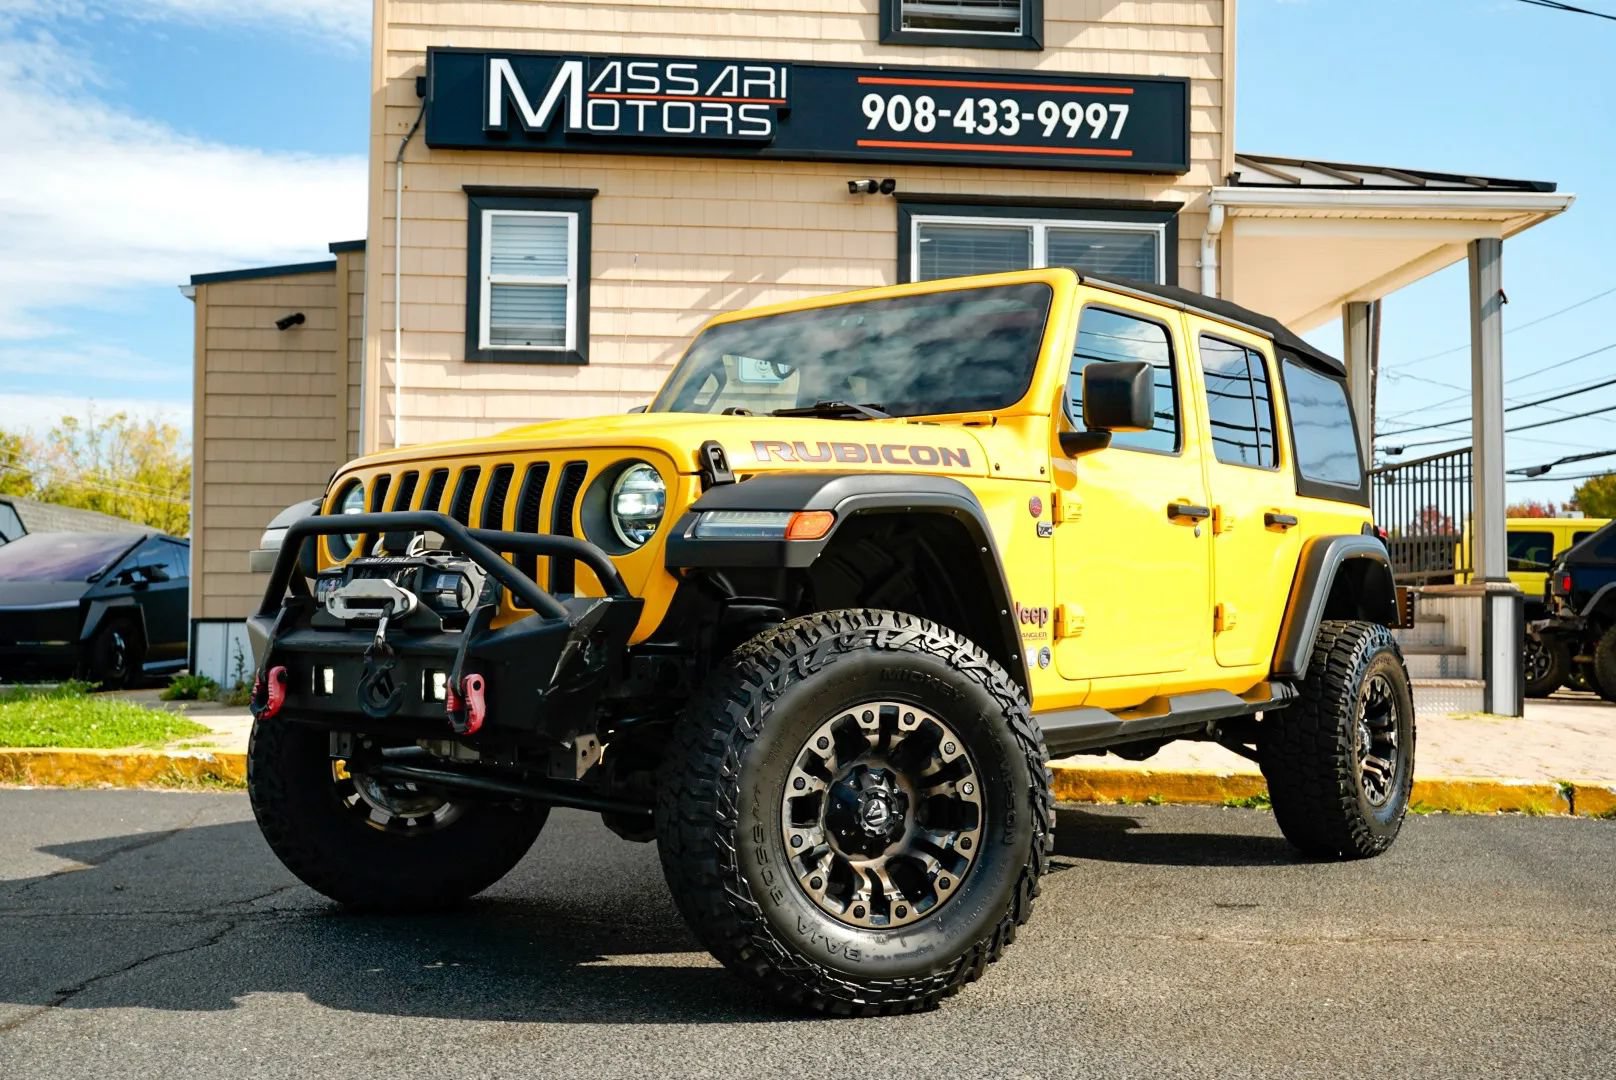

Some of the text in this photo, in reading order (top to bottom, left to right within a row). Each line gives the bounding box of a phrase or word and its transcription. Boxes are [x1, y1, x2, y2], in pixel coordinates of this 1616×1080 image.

[488, 57, 787, 129] MASSARI
[861, 93, 1130, 140] 908-433-9997
[750, 440, 971, 468] RUBICON
[751, 824, 785, 908] BOSS
[797, 915, 862, 964] BAJA
